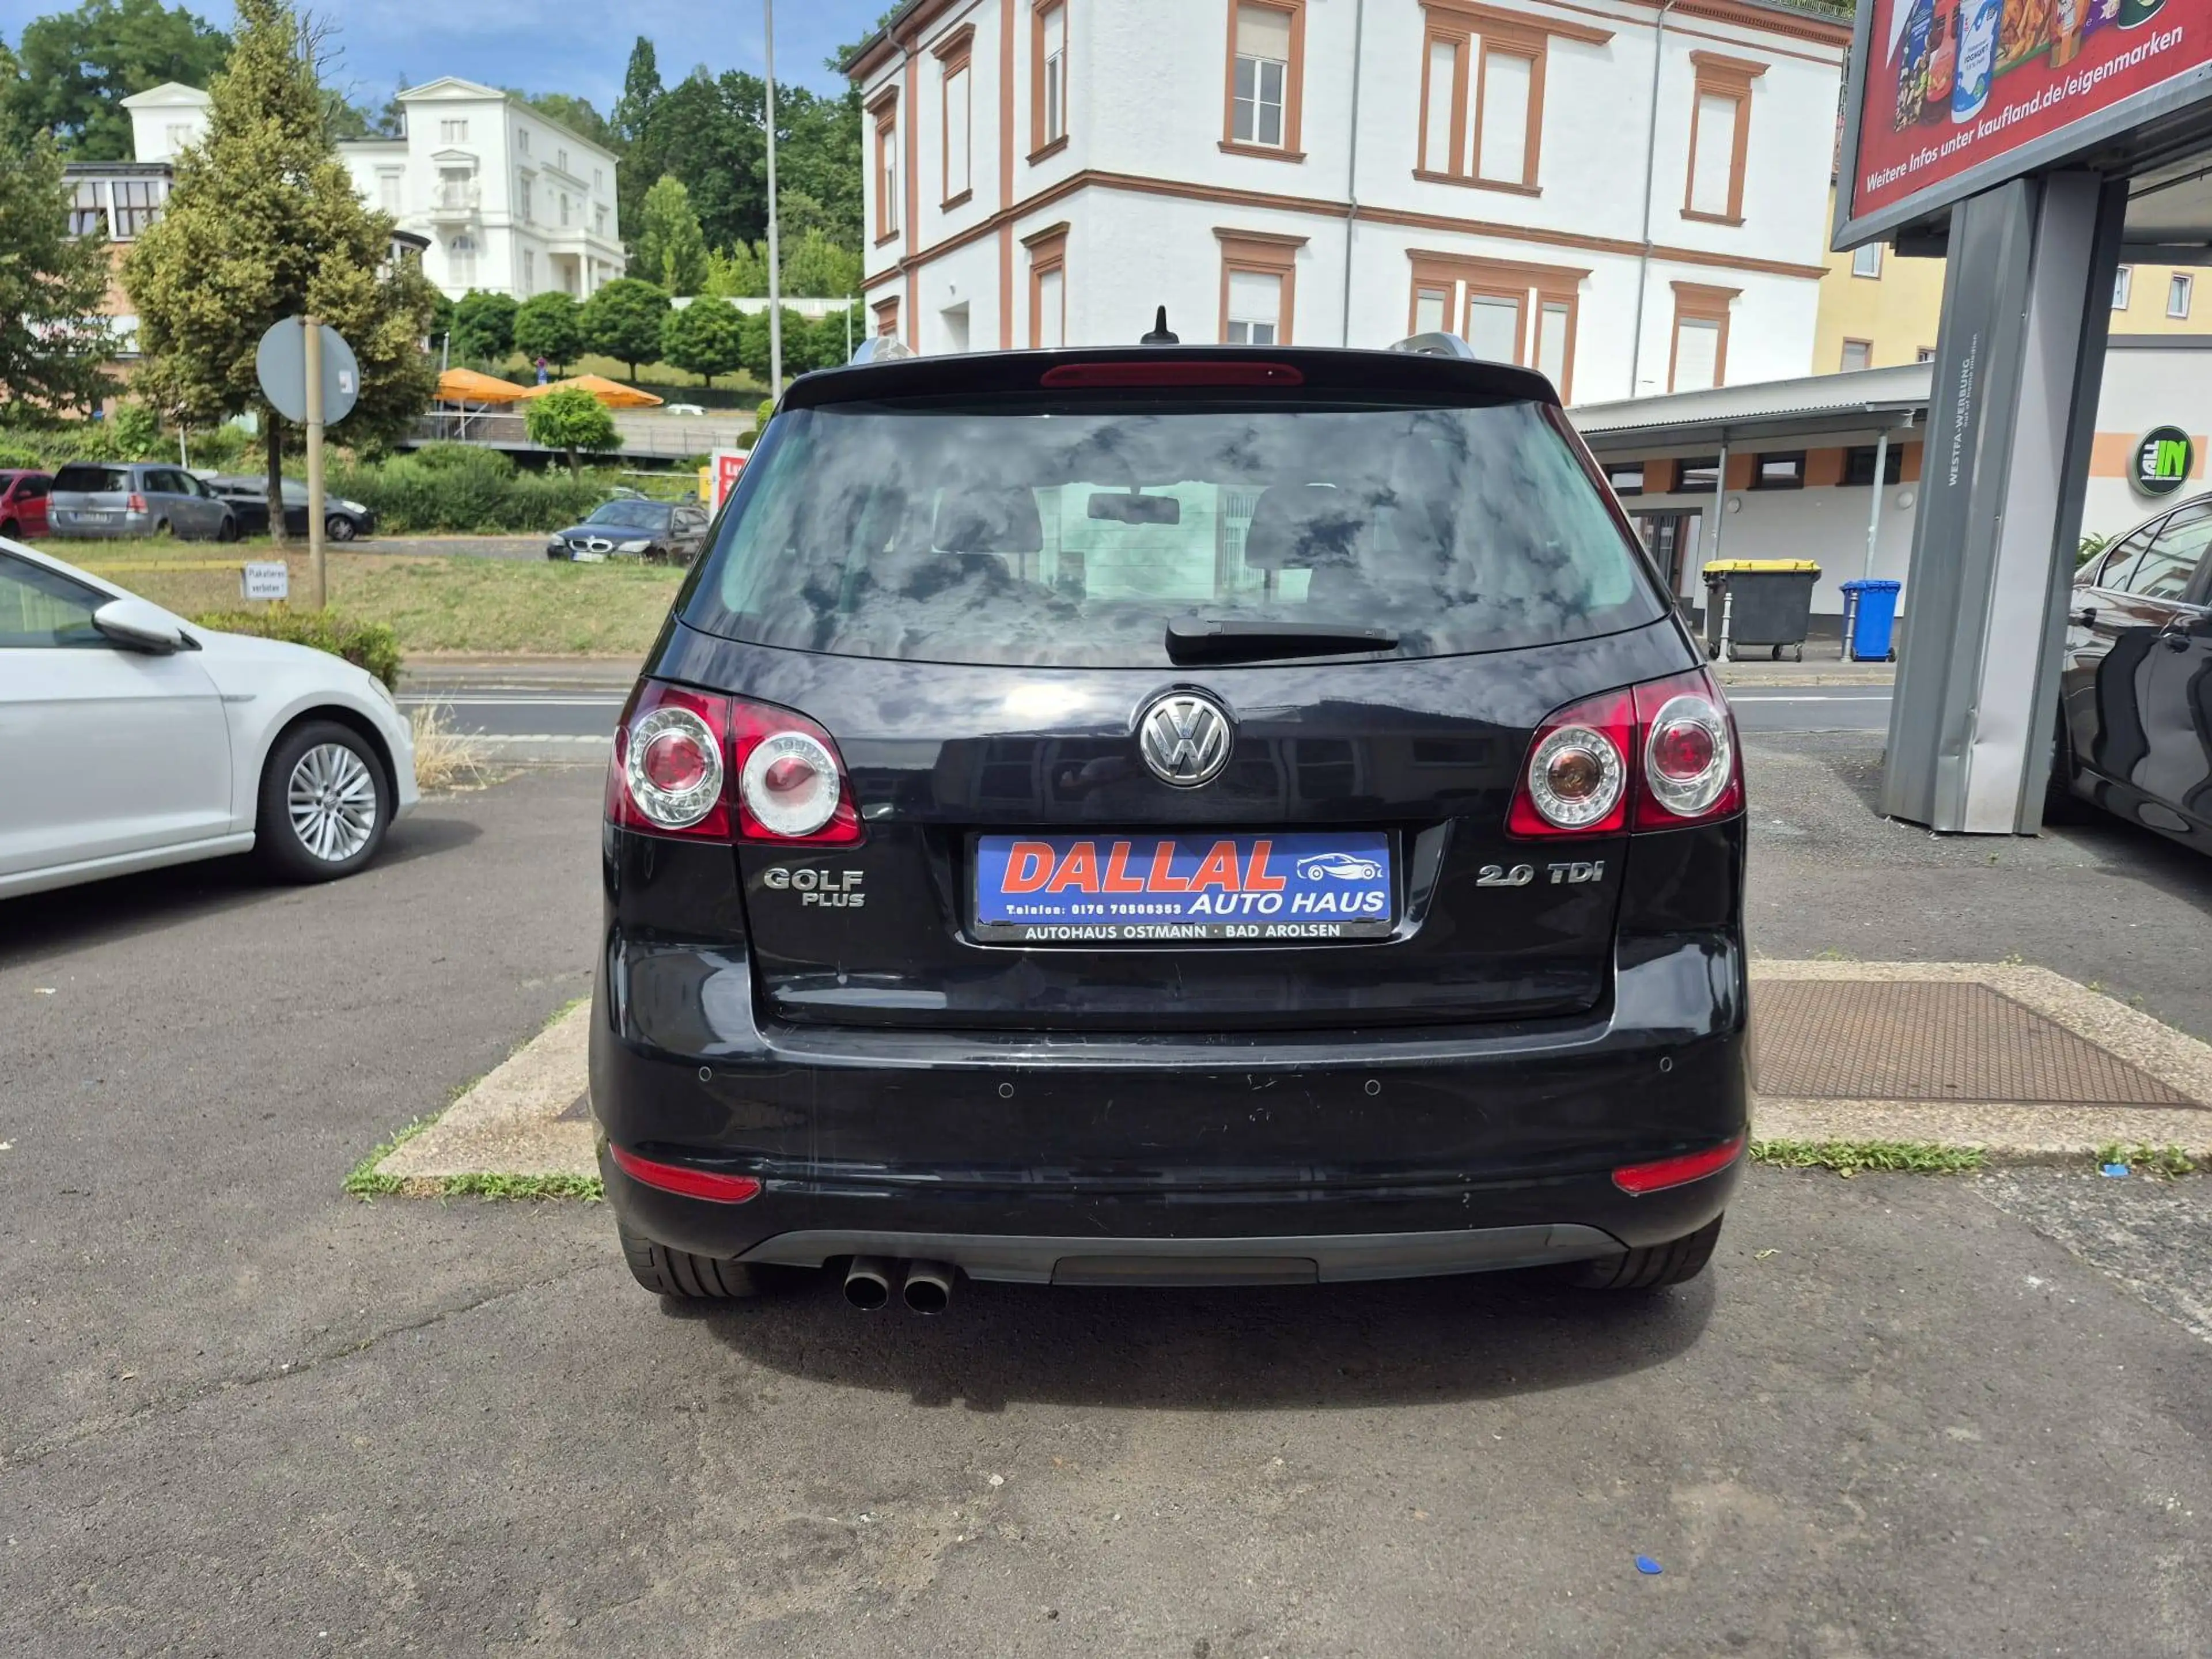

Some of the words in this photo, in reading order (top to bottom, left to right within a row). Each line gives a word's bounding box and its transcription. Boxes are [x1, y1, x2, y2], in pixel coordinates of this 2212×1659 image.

[1866, 162, 1907, 193] Weitere
[1908, 146, 1938, 173] Infos
[1941, 127, 1975, 157] unter
[1977, 25, 2184, 139] kaufland.de/eigenmarken
[1948, 358, 1970, 487] WESTFA-WERBUNG
[1001, 841, 1286, 893] DALLAL
[1547, 860, 1606, 884] TDI
[764, 868, 864, 891] GOLF
[802, 892, 866, 907] PLUS
[1071, 904, 1104, 915] 0176
[1187, 893, 1283, 915] AUTO
[1290, 891, 1385, 914] HAUS
[1025, 926, 1118, 940] AUTOHAUS
[1123, 925, 1207, 940] OSTMANN
[1225, 925, 1259, 938] BAD
[1264, 923, 1341, 937] AROLSEN
